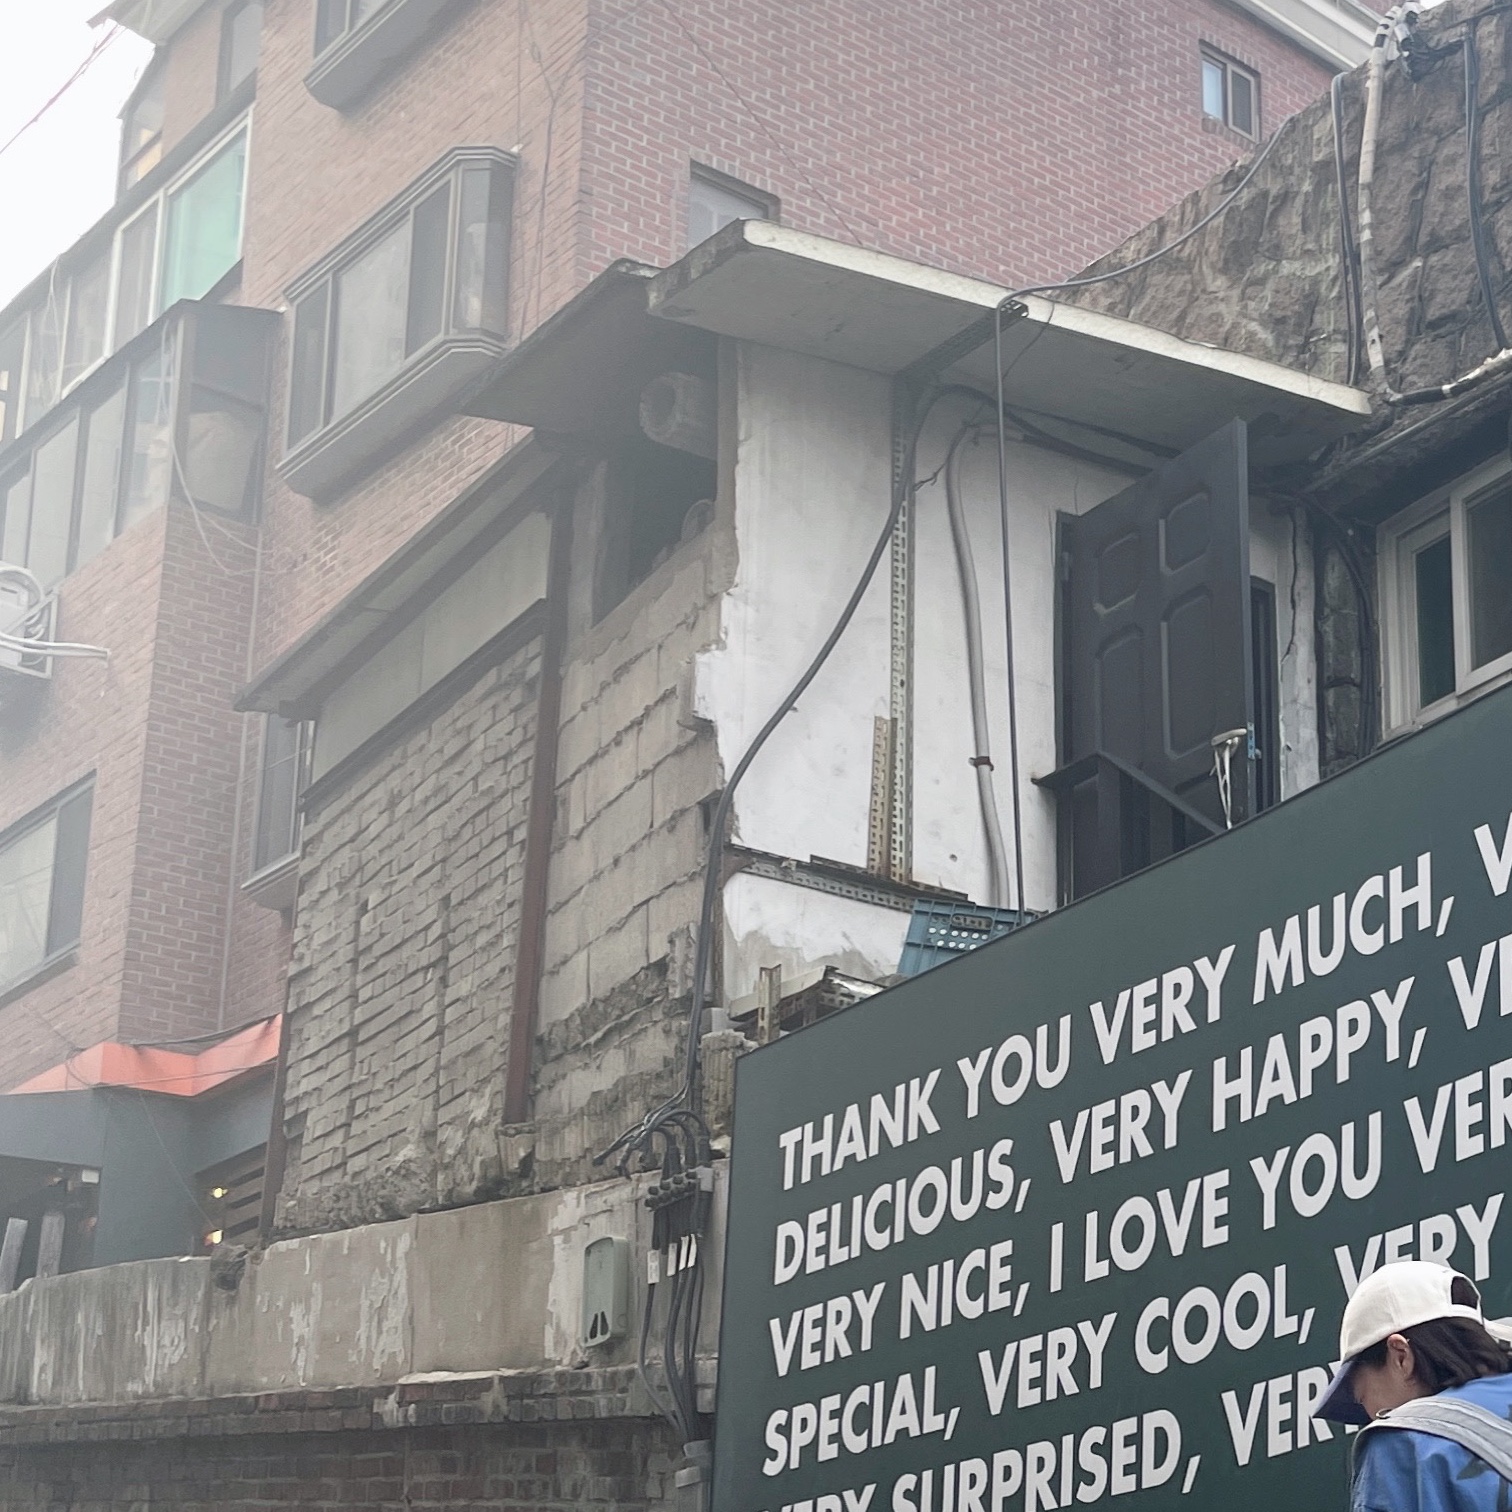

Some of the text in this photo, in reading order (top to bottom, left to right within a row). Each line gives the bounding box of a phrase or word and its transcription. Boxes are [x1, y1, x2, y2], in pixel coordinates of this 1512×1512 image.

[774, 1139, 1031, 1285] DELICIOUS,
[1050, 1070, 1192, 1184] VERY
[1213, 977, 1428, 1132] HAPPY,
[780, 1069, 942, 1190] THANK
[957, 1015, 1071, 1118] YOU
[1090, 945, 1235, 1064] VERY
[1253, 852, 1454, 1004] MUCH,
[762, 1366, 960, 1476] SPECIAL,
[979, 1312, 1117, 1415] VERY
[1135, 1265, 1316, 1373] COOL,
[769, 1282, 885, 1377] VERY
[900, 1240, 1030, 1339] NICE,
[1050, 1223, 1064, 1292] I
[1085, 1169, 1229, 1283] LOVE
[1250, 1111, 1381, 1230] YOU
[1222, 1358, 1361, 1466] VER
